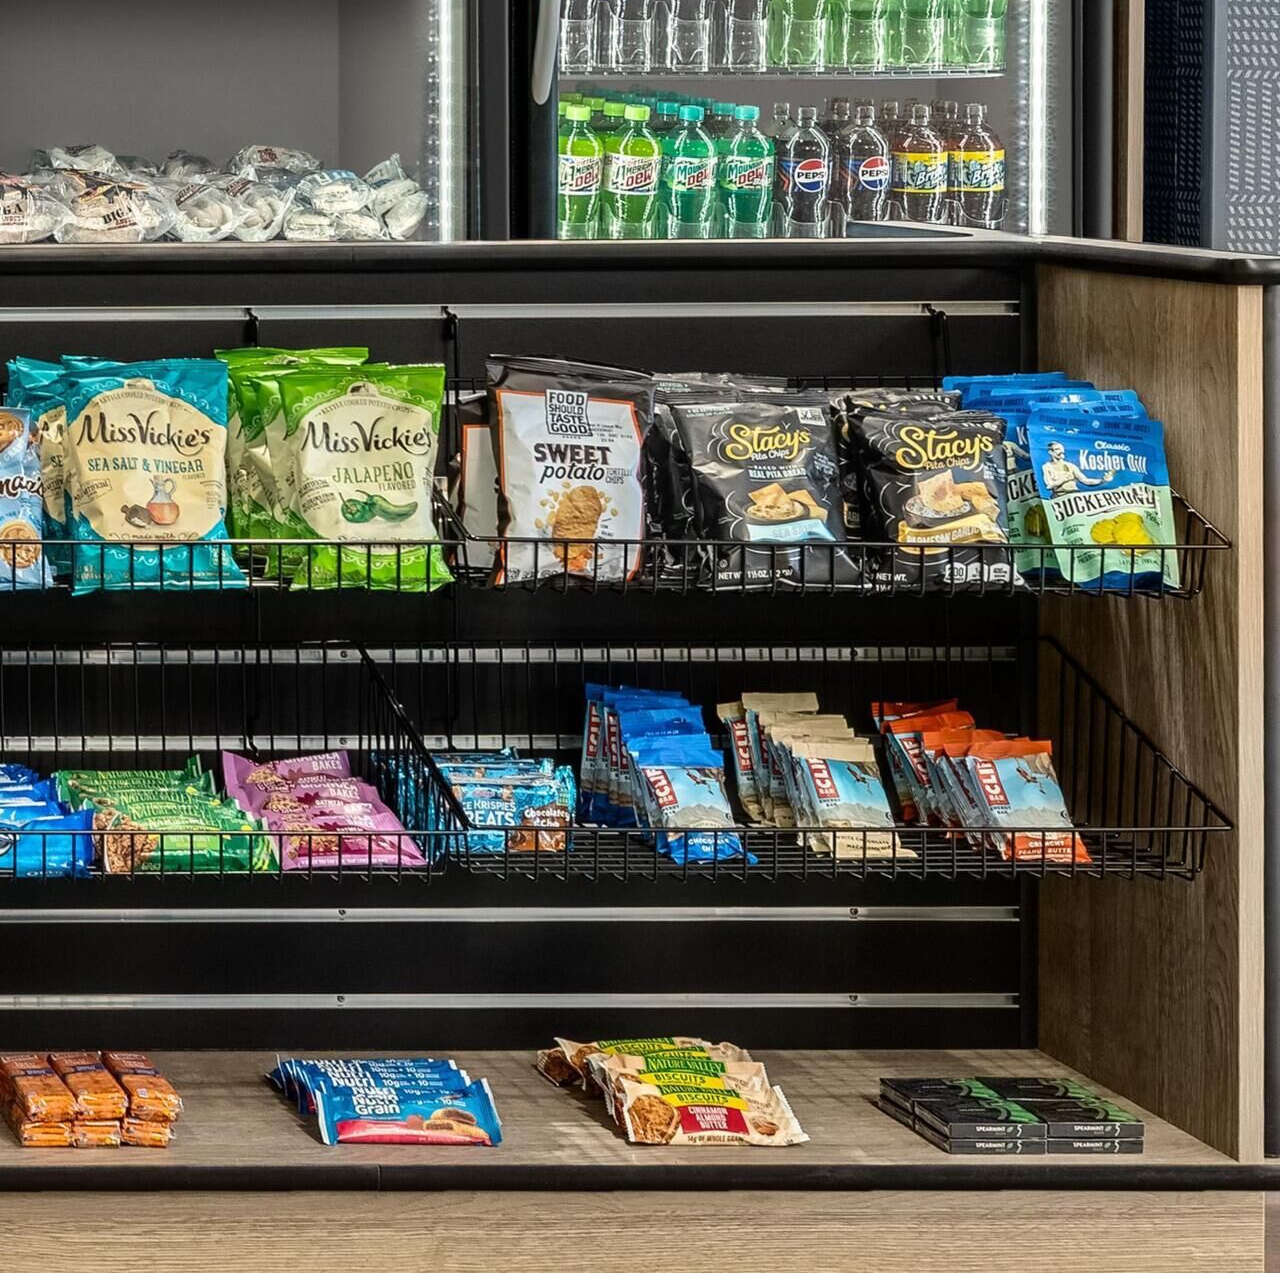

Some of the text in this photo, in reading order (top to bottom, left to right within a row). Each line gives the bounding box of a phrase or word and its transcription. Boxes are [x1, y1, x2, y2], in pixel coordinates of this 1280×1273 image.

[626, 168, 653, 187] DEW
[549, 392, 585, 406] FOOD
[549, 403, 584, 415] SHOULD
[549, 413, 585, 424] TASTE
[77, 410, 212, 457] Miss Vickie's
[551, 423, 587, 434] GOOD
[301, 421, 360, 453] Miss
[725, 423, 811, 461] Stacy's
[896, 426, 993, 470] Stacy's
[1094, 440, 1131, 452] Classic
[534, 443, 612, 465] SWEET
[751, 449, 790, 462] Pita Chips
[88, 457, 204, 474] SEA SALT & VINEGAR
[924, 457, 970, 470] Pita Chips
[1079, 449, 1148, 474] Kosher Dill
[332, 461, 415, 484] JALAPEÑO
[540, 462, 604, 484] potato
[749, 468, 807, 479] REAL PITA BREAD
[378, 480, 417, 492] FLAVORED
[605, 476, 624, 484] CHIPS
[907, 527, 981, 543] PARMESAN GARLIC
[875, 573, 891, 581] NET
[312, 760, 343, 772] BAKES
[329, 788, 360, 800] BAKES
[473, 800, 516, 813] KRISPIES
[524, 804, 570, 821] Chocolatey
[465, 811, 516, 826] REATS
[646, 1057, 723, 1074] NATURE VALLEY
[332, 1074, 429, 1089] Nutri 10g 10
[654, 1073, 707, 1085] BISCUITS
[677, 1092, 729, 1104] BISCUITS
[354, 1104, 401, 1116] Grain
[689, 1106, 728, 1115] CINNAMON
[695, 1113, 727, 1122] ALMOND
[699, 1120, 728, 1131] BUTTER
[976, 1125, 1006, 1133] SPEARMINT
[707, 1135, 726, 1143] WHOLE
